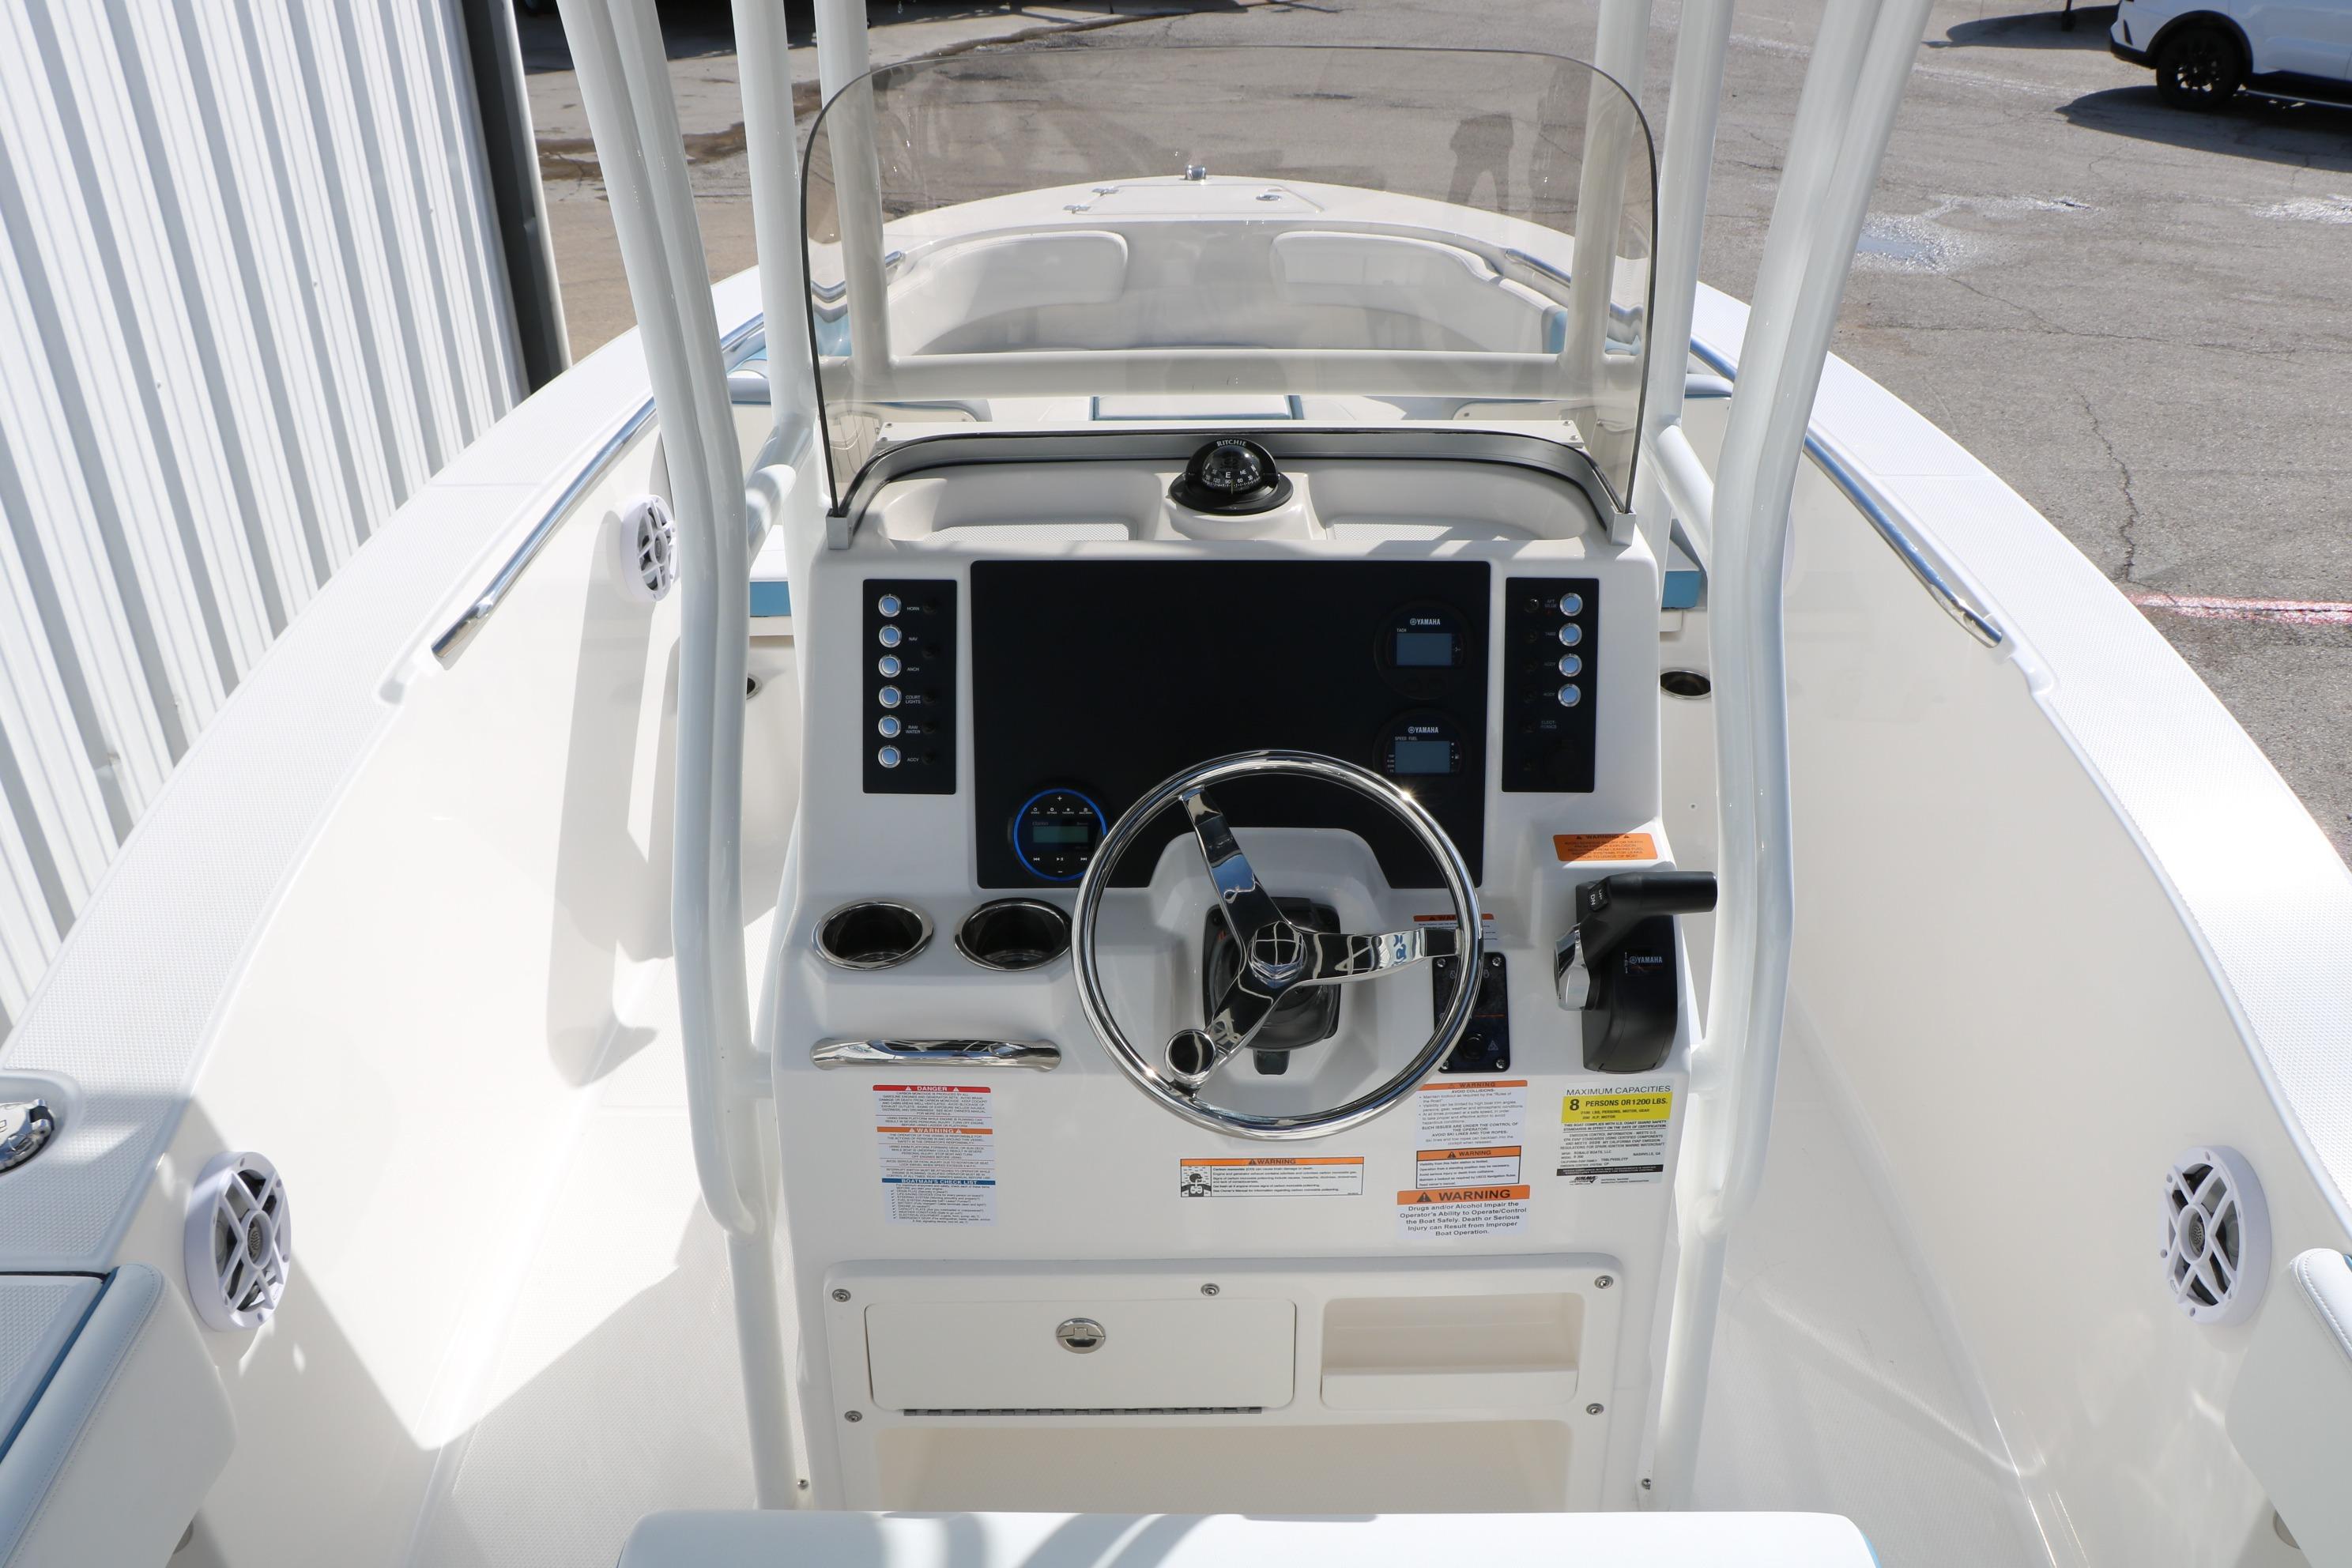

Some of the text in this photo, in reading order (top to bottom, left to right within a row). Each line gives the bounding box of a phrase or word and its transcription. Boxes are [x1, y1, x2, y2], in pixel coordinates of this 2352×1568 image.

[1590, 894, 1596, 905] DN
[1570, 1099, 1579, 1110] 8
[1439, 1189, 1510, 1200] WARNING
